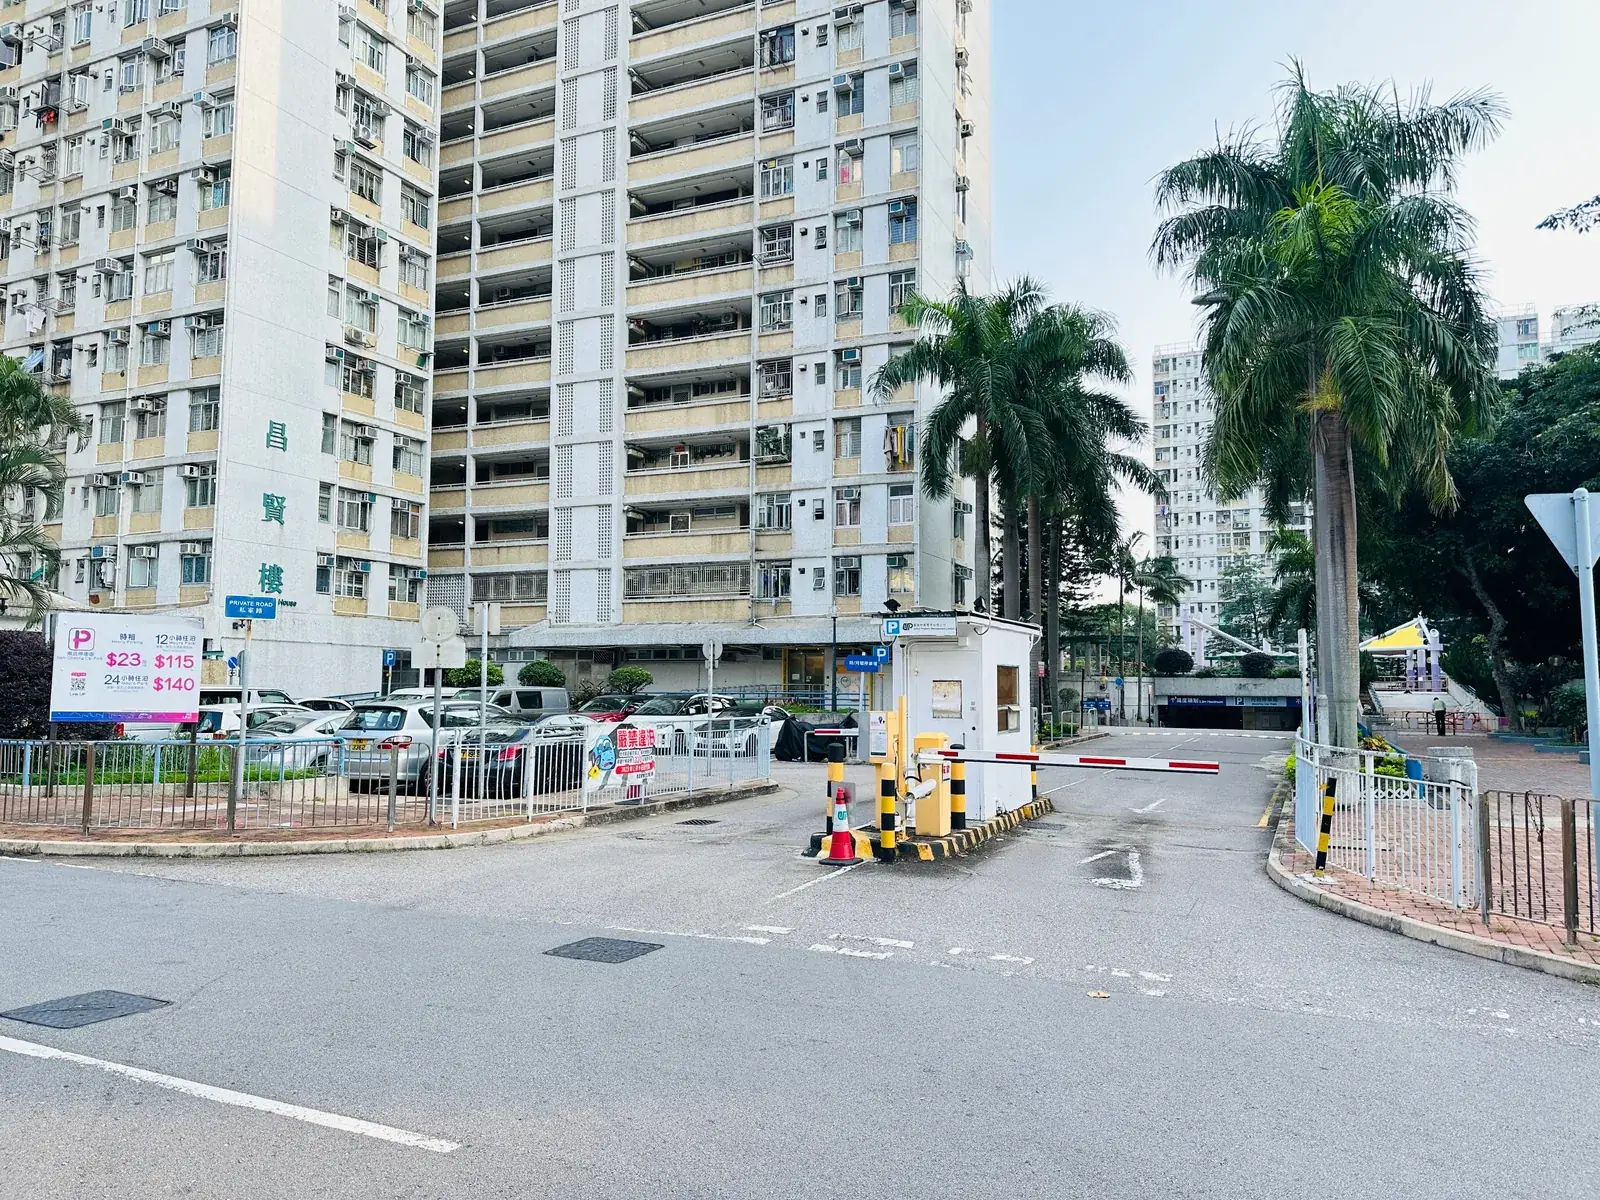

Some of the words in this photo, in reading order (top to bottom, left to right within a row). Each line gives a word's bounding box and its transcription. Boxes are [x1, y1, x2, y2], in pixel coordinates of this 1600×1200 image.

[257, 419, 288, 595] 昌賢樓
[278, 599, 297, 608] House
[887, 621, 899, 634] P
[155, 634, 169, 645] 12
[106, 652, 141, 667] $23
[154, 654, 195, 669] $115
[386, 653, 394, 665] P
[876, 648, 887, 662] P
[104, 674, 120, 685] 24
[153, 676, 195, 692] $140
[1236, 697, 1243, 705] P
